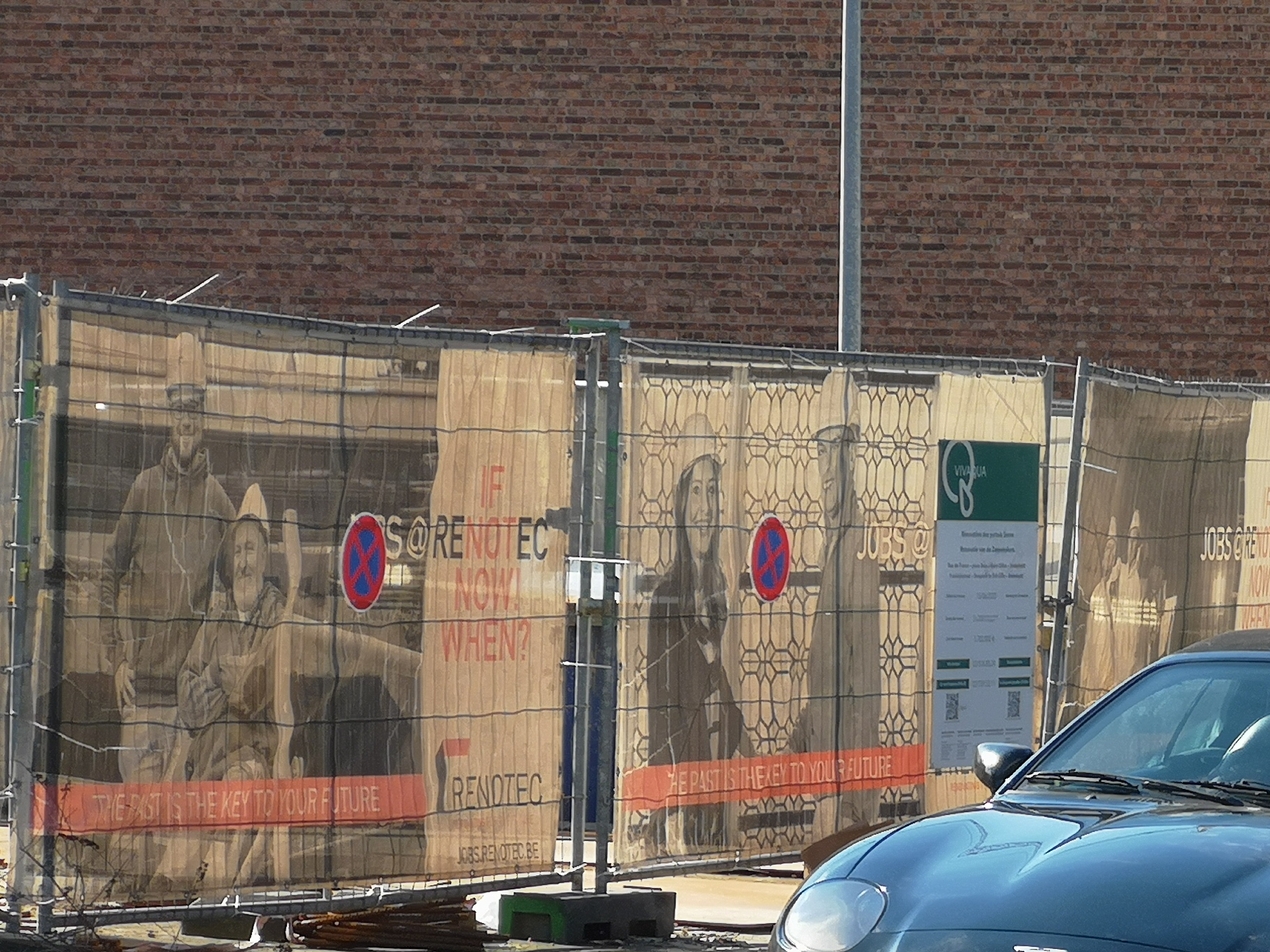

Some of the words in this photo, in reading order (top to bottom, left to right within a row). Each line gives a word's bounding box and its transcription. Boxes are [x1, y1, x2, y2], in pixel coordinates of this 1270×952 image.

[480, 465, 505, 508] IF
[954, 465, 987, 479] VIVAQUA
[454, 567, 521, 612] NOW!
[441, 619, 531, 662] WHEN?
[452, 773, 542, 810] RENOTEC
[690, 769, 722, 793] PAST
[739, 766, 765, 789] THE
[789, 763, 806, 784] TO
[809, 759, 846, 783] YOUR
[849, 754, 893, 780] FUTURE
[166, 791, 183, 819] IS
[186, 790, 218, 818] THE
[220, 789, 248, 817] KEY
[252, 788, 272, 816] TO
[278, 787, 318, 815] YOUR
[321, 785, 381, 815] FUTURE
